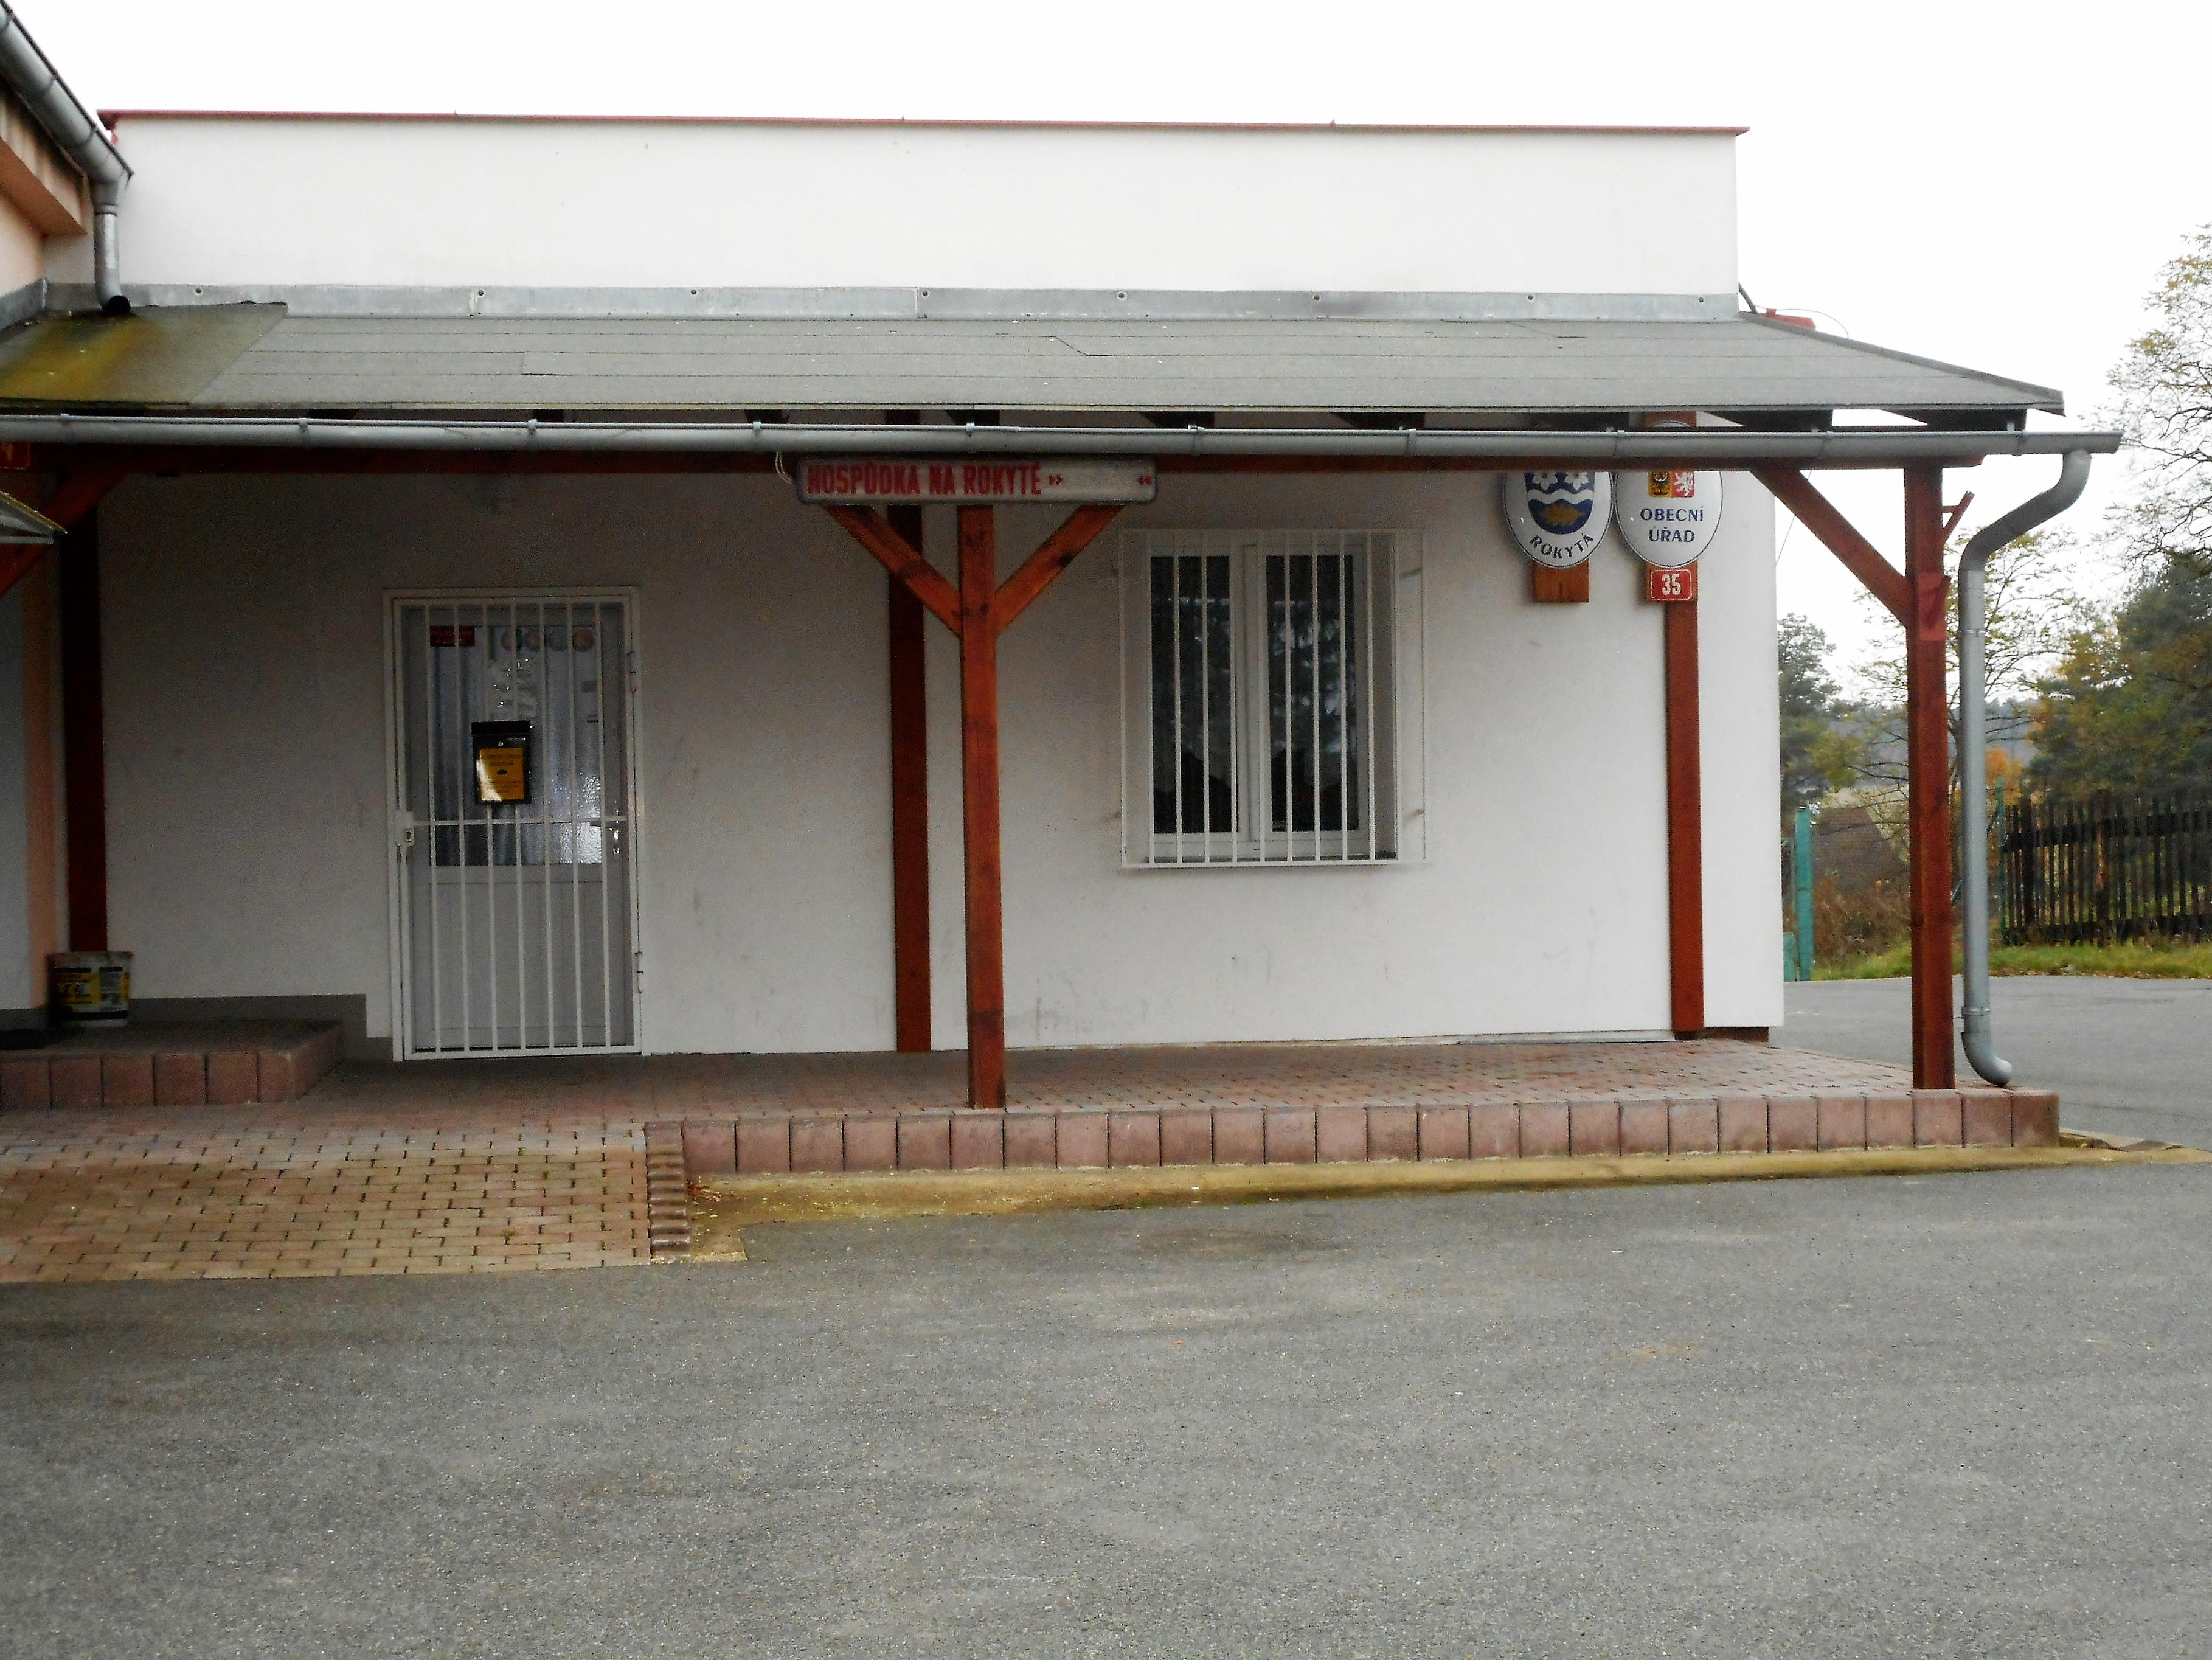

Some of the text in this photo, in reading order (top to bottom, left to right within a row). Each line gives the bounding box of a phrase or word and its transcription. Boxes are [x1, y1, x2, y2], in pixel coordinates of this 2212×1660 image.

[929, 465, 955, 495] NA
[1640, 505, 1704, 522] OBECNÍ
[1649, 526, 1695, 543] ÚŘAD
[1661, 574, 1682, 596] 35
